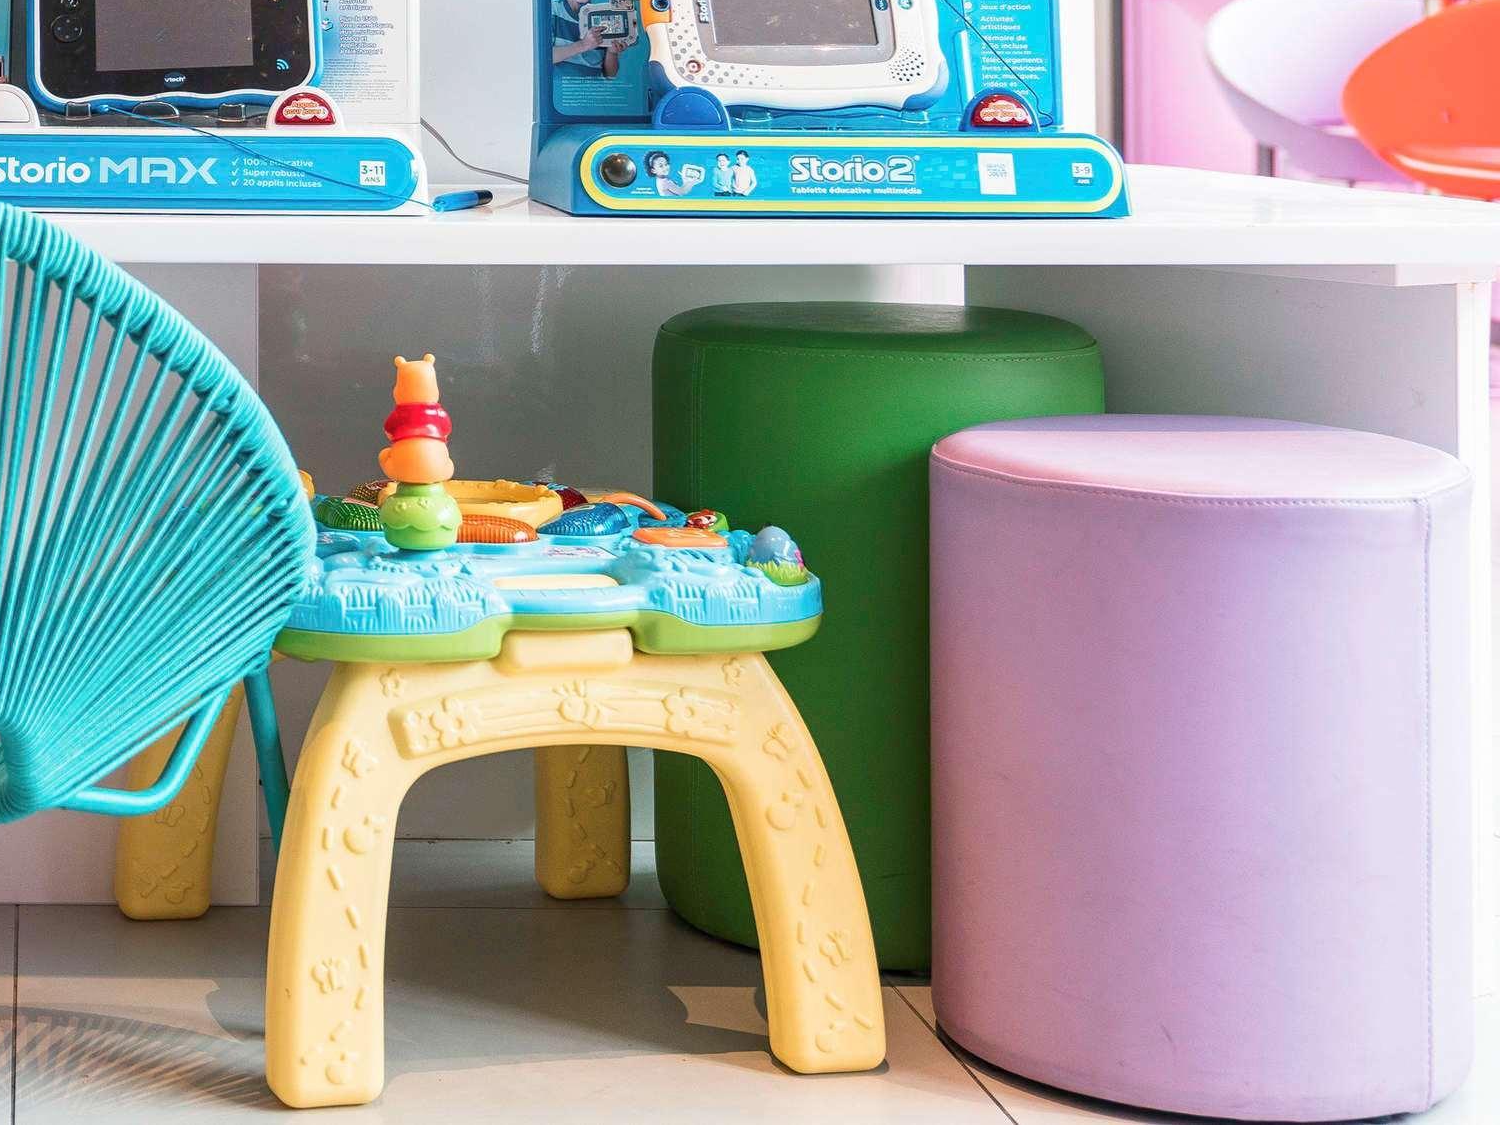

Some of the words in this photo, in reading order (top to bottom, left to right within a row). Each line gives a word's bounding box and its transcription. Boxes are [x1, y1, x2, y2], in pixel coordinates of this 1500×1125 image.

[102, 157, 217, 184] MAX
[243, 169, 270, 178] Super
[361, 165, 384, 175] 3-11
[790, 155, 886, 182] Storio
[888, 156, 915, 182] 2
[1074, 165, 1091, 175] 3-9
[257, 179, 285, 188] applis
[286, 179, 322, 188] incluses
[829, 186, 872, 194] éducative
[873, 186, 922, 194] multimédia
